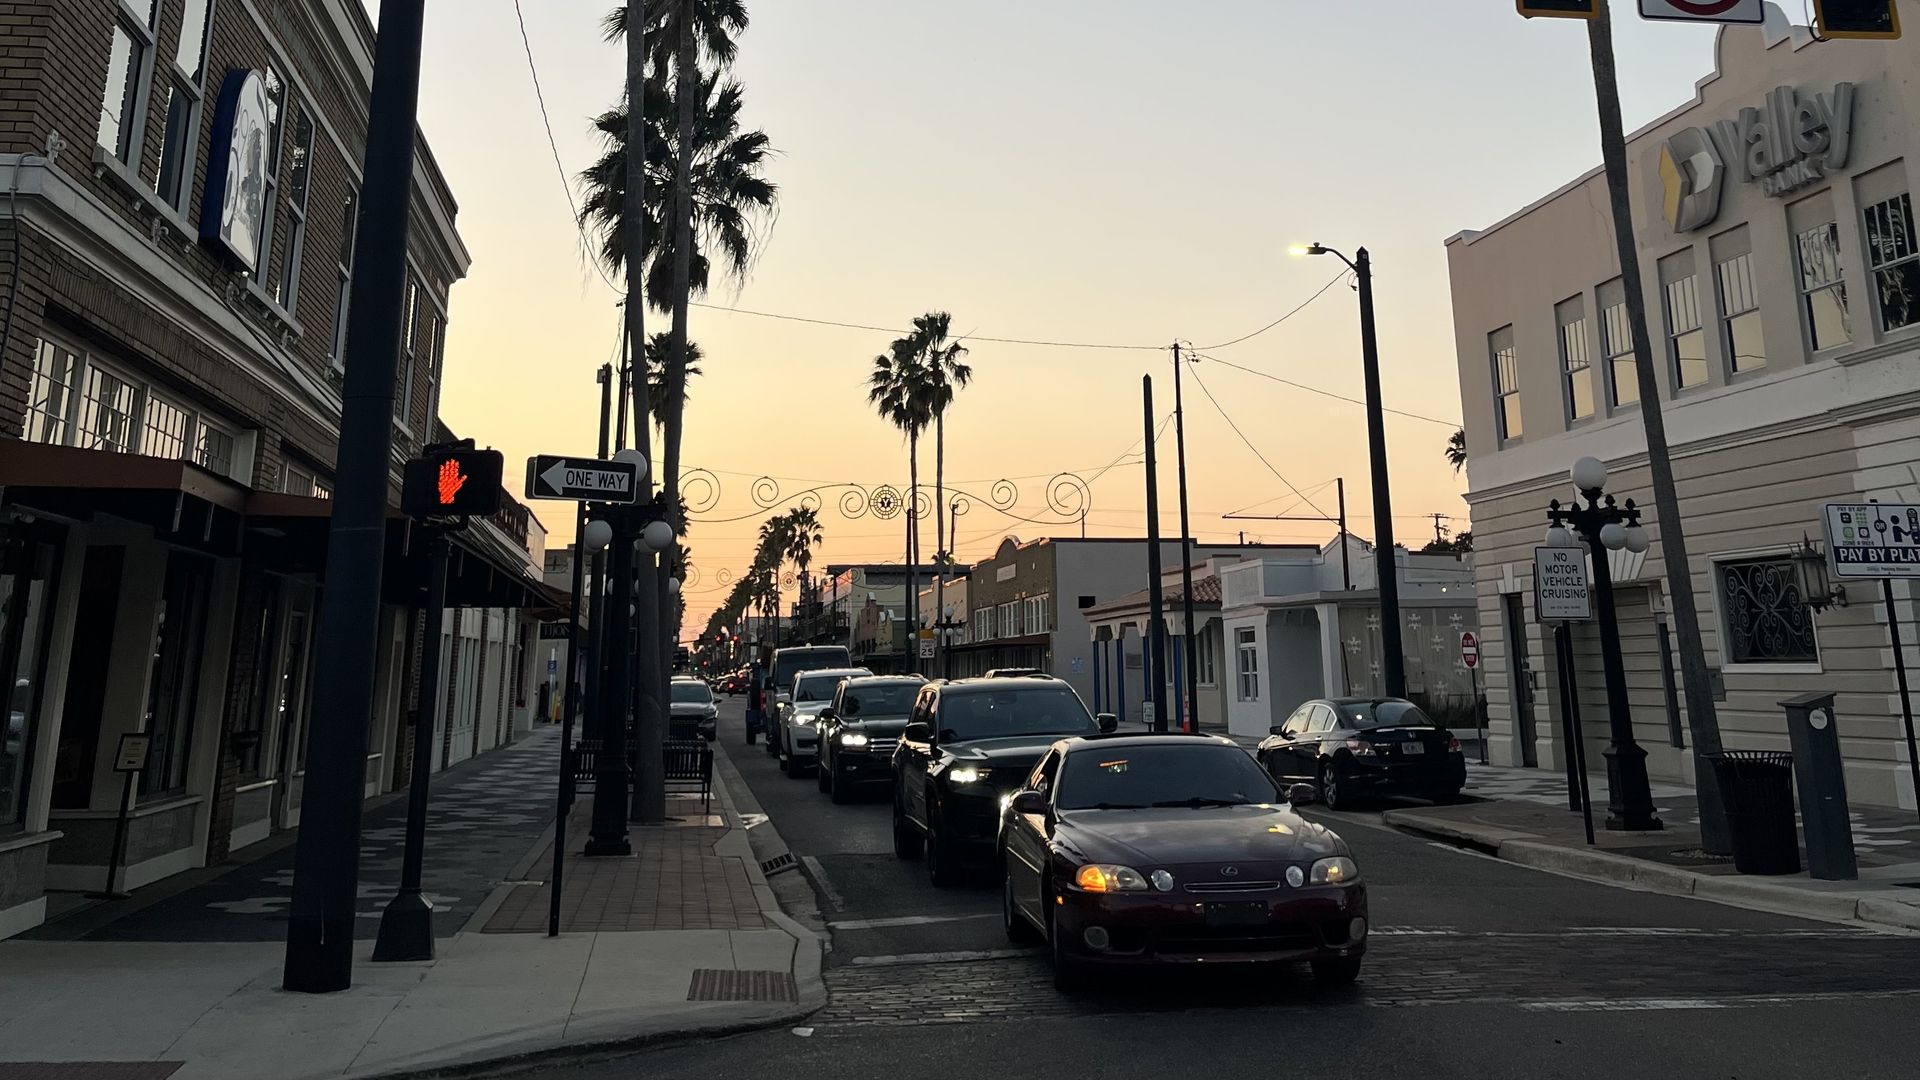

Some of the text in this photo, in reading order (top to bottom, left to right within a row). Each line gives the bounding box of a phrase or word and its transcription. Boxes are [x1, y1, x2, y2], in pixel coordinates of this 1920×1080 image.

[1713, 82, 1853, 183] Valley
[566, 470, 625, 489] ONE WAY
[1553, 552, 1567, 562] NO
[1839, 548, 1864, 562] PAY
[1868, 548, 1886, 562] BY
[1545, 564, 1578, 574] MOTOR
[1542, 576, 1583, 587] VEHICLE
[1541, 588, 1587, 599] CRUISING
[921, 648, 934, 656] 25
